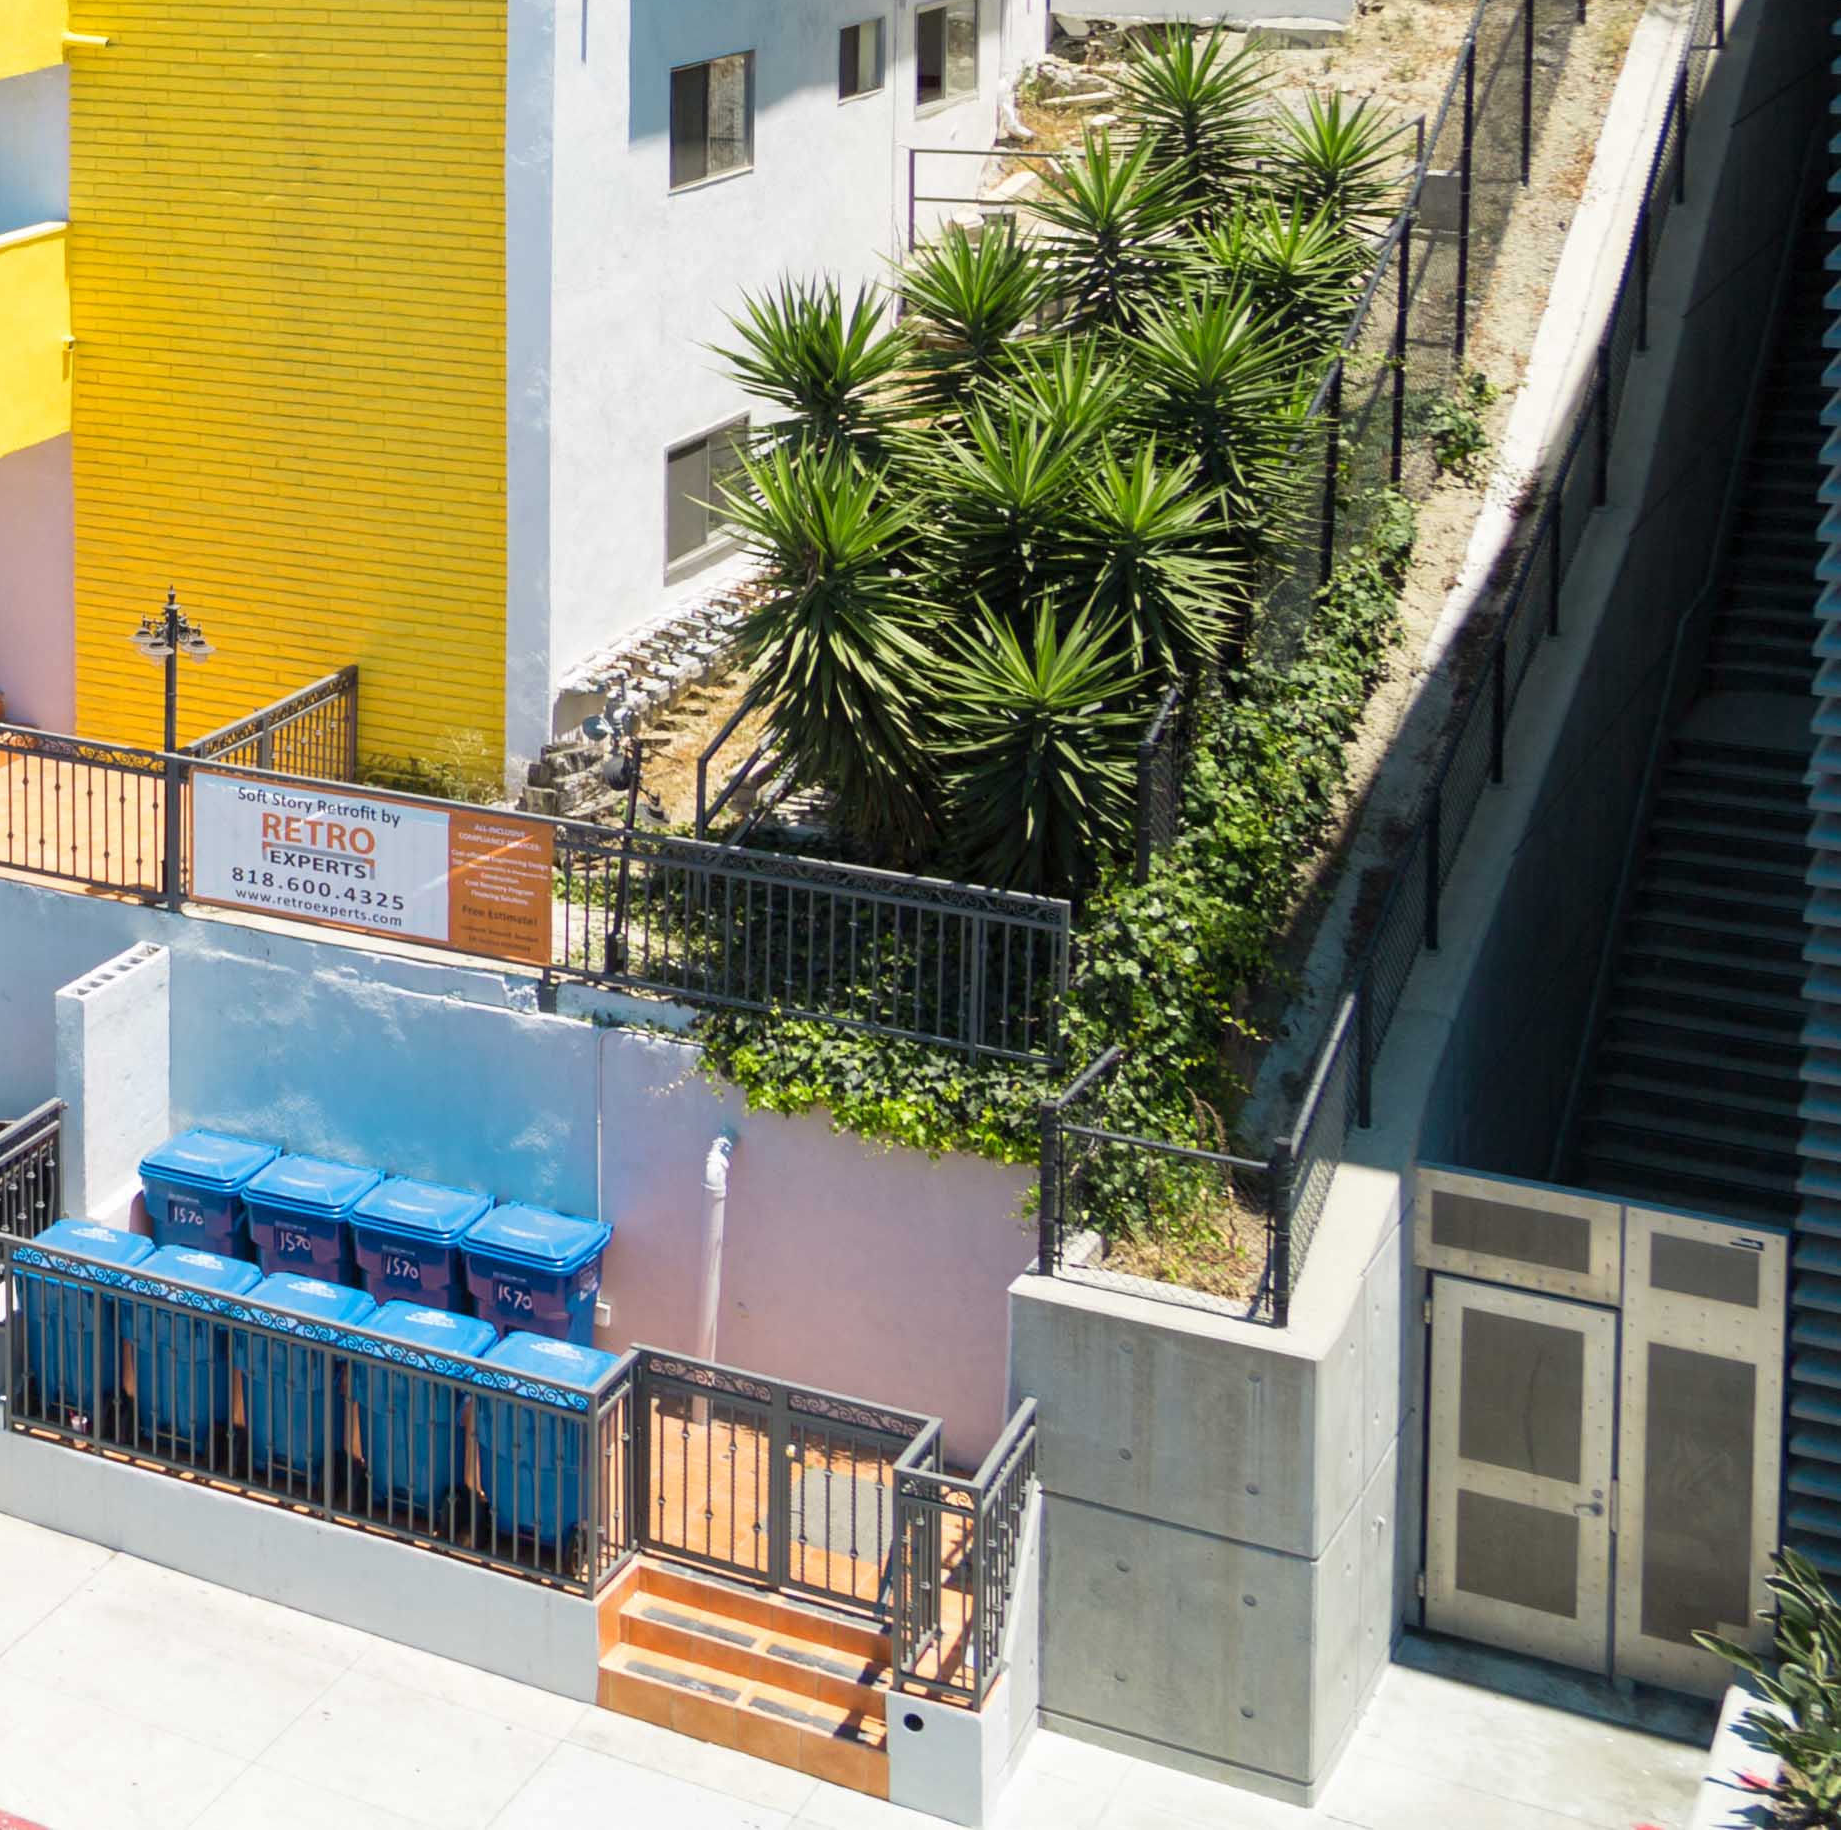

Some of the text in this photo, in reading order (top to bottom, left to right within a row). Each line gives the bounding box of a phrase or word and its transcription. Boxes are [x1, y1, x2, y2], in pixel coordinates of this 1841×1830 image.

[238, 786, 401, 829] Soft Story Retrofit by
[261, 811, 376, 856] RETRO
[270, 849, 367, 880] EXPERTS
[232, 866, 405, 911] 818.600.4325
[234, 888, 403, 927] www.retroexperts.com
[173, 1205, 205, 1226] 1570
[280, 1230, 312, 1252] 1570
[386, 1254, 420, 1280] 1570
[498, 1283, 533, 1311] 1570
